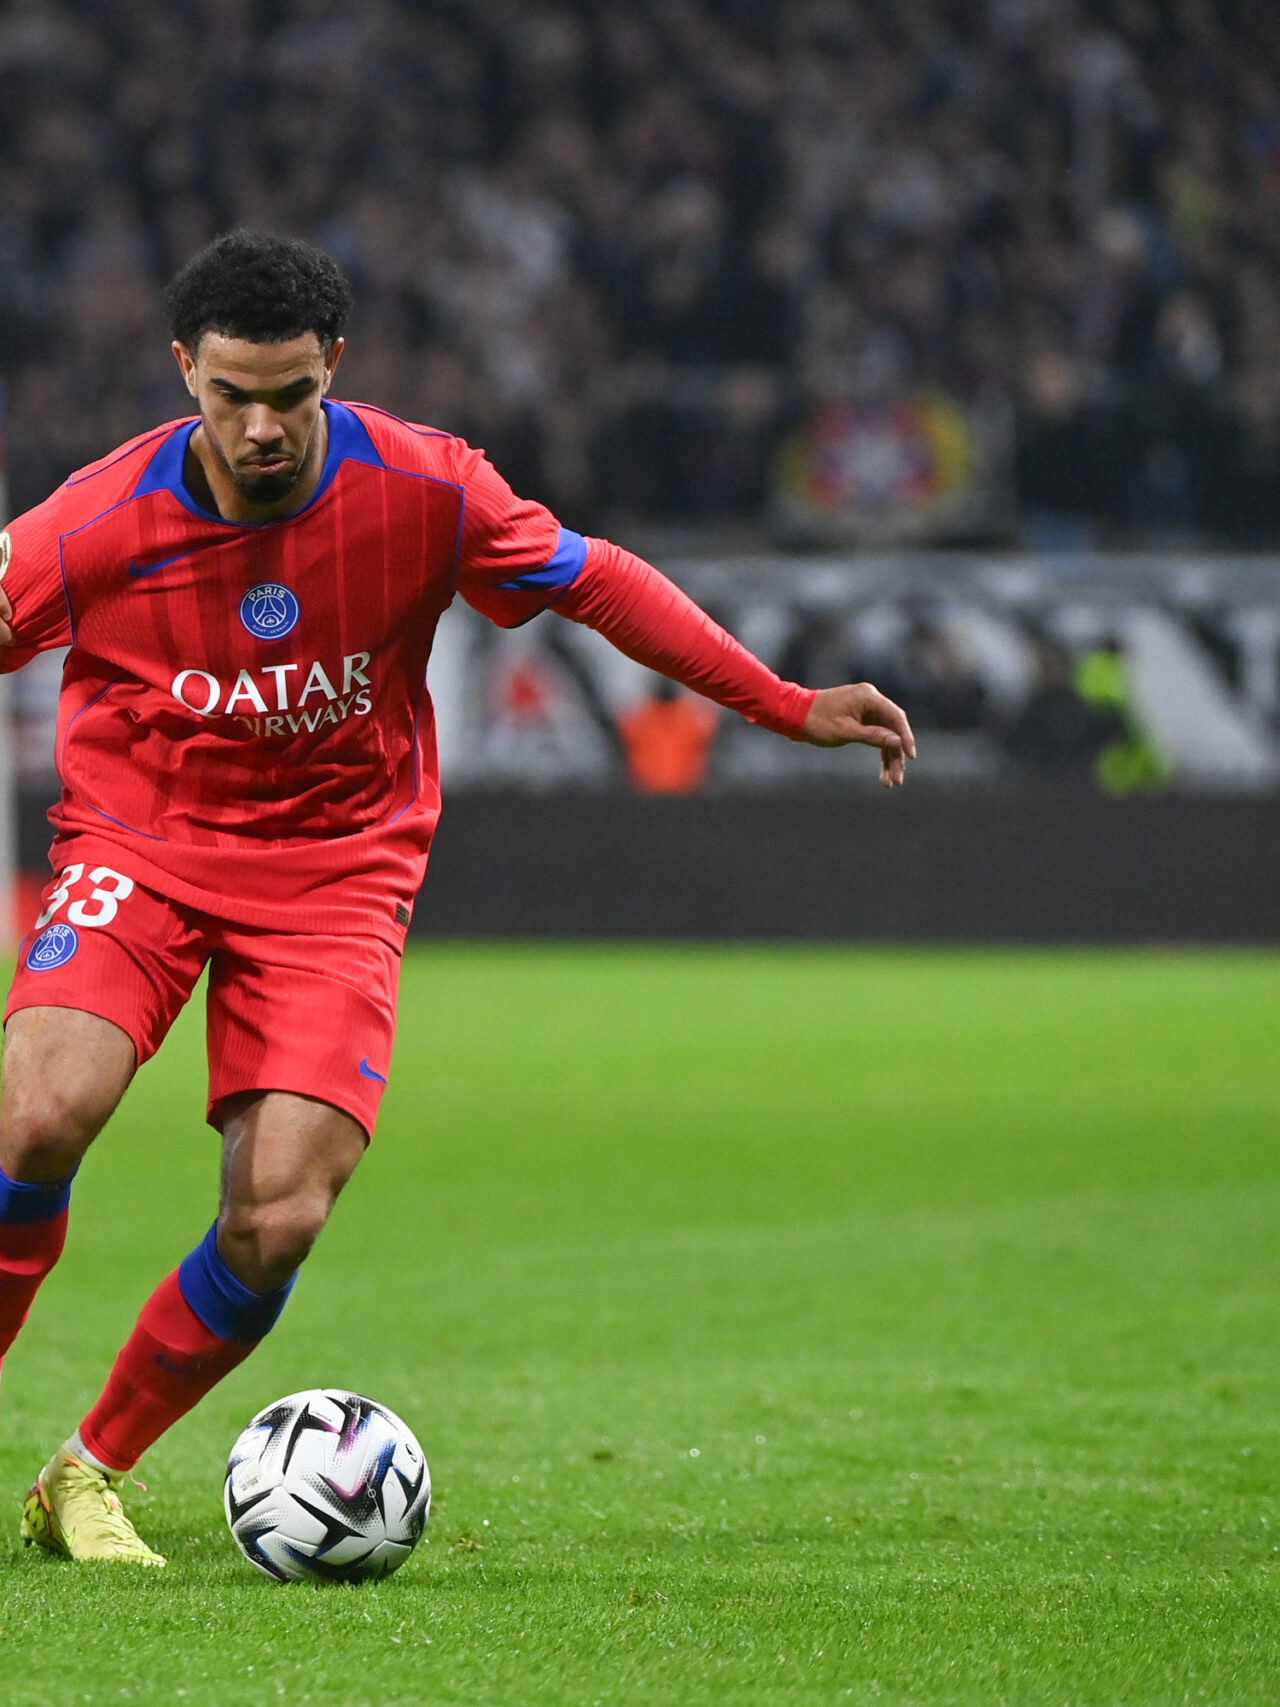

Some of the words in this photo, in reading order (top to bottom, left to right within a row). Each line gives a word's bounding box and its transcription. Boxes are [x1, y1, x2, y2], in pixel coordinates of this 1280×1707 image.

[248, 587, 286, 602] PARIS
[171, 651, 372, 719] QATAR
[34, 863, 135, 930] 33
[40, 926, 71, 942] PARIS
